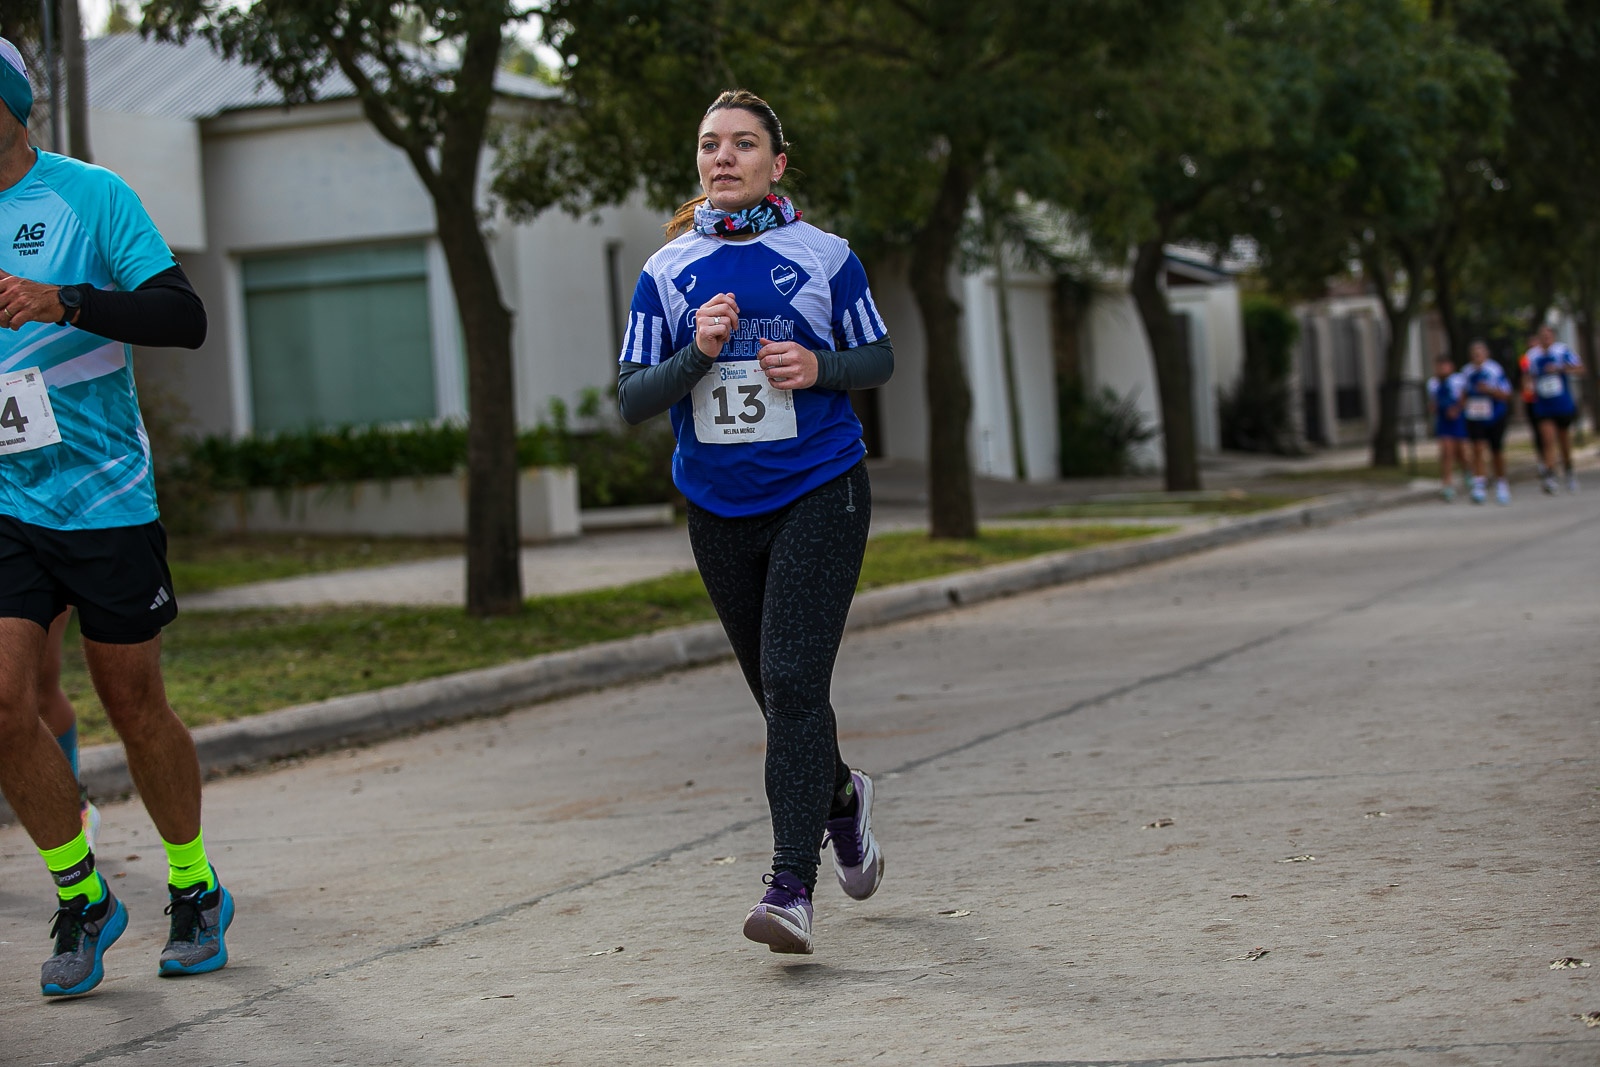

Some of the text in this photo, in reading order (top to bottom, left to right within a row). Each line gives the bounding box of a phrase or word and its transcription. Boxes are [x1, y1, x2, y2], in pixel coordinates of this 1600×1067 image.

[13, 222, 46, 242] AG
[12, 240, 45, 250] RUNNING
[18, 248, 40, 257] TEAM
[729, 315, 795, 340] ARATÓN
[719, 367, 727, 381] 3
[711, 384, 766, 425] 13
[0, 395, 30, 433] 4
[740, 426, 756, 434] MUÑOZ
